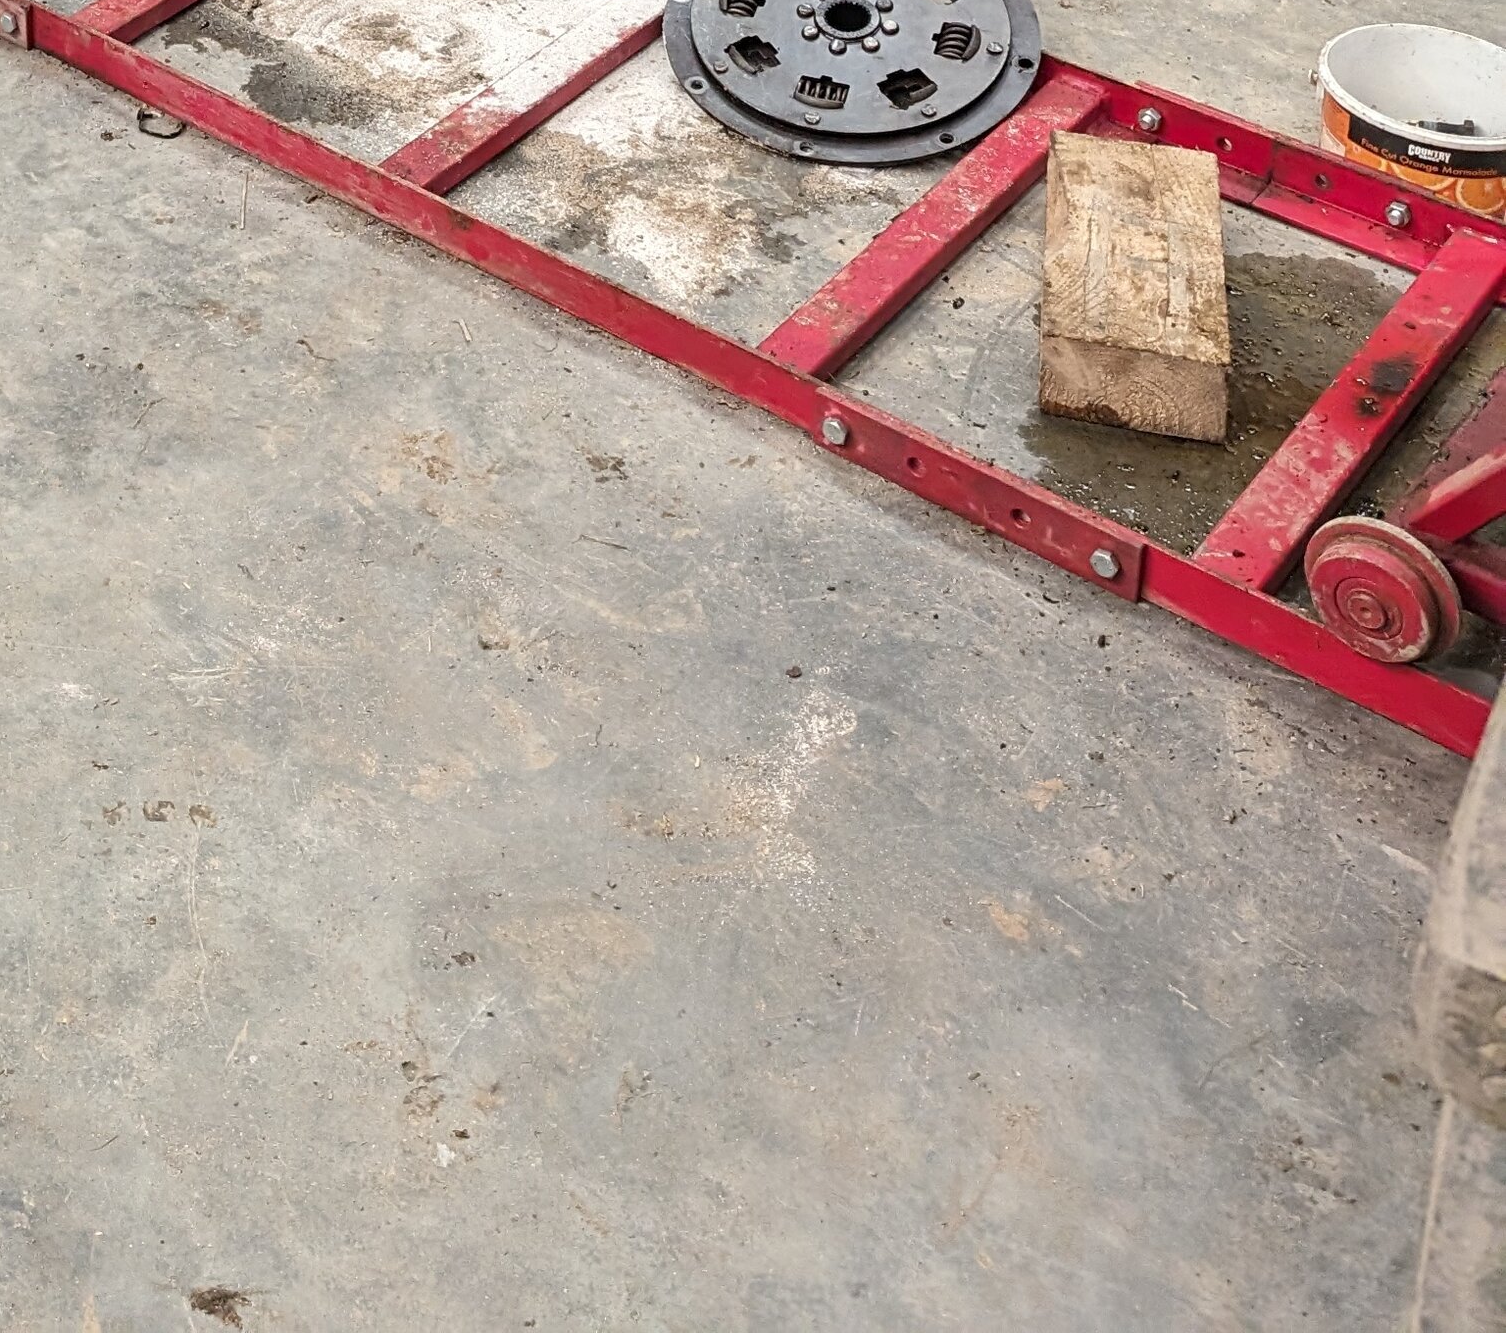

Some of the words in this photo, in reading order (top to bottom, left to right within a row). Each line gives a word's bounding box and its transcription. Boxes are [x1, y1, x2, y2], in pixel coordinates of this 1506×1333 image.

[1361, 137, 1379, 153] Fine
[1381, 148, 1397, 160] Cut
[1399, 155, 1439, 173] Orange
[1442, 166, 1498, 176] Marmalade
[1408, 144, 1451, 164] COUNTRY
